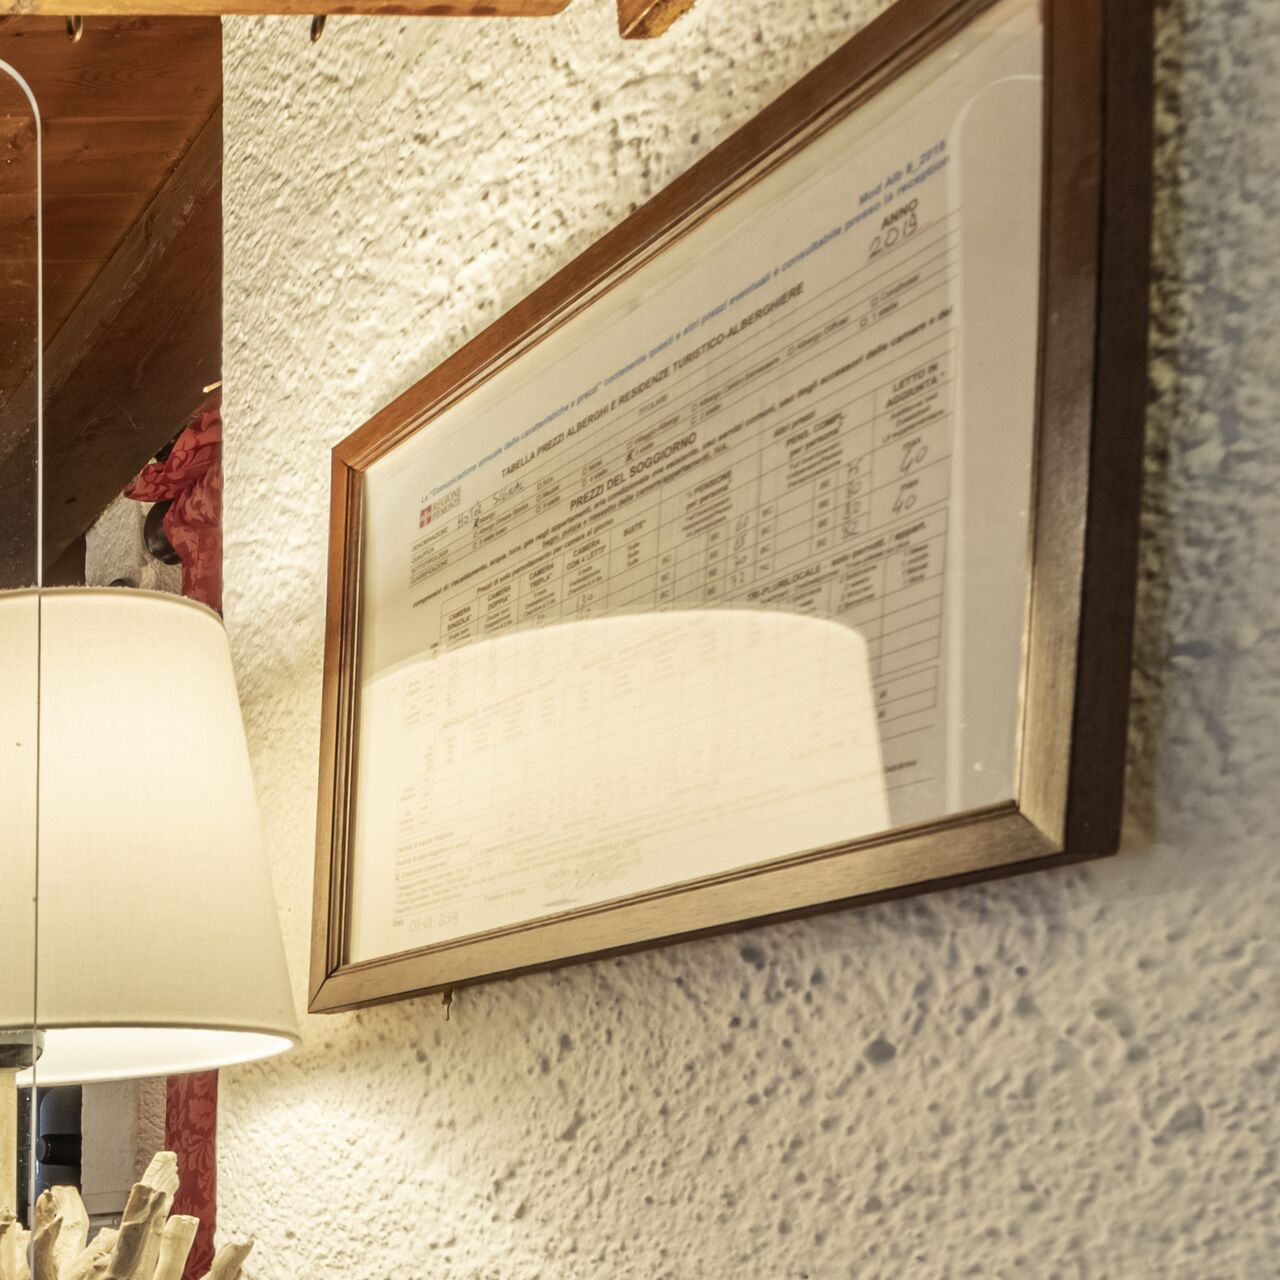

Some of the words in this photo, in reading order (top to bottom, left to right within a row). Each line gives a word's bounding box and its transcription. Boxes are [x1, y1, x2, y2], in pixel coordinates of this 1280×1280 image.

[881, 196, 918, 231] ANNO
[782, 223, 841, 272] consultabile
[845, 199, 880, 232] presso
[502, 449, 534, 478] TABELLA
[536, 431, 564, 457] PREZZI
[567, 404, 608, 438] ALBERGHI
[618, 365, 670, 406] RESIDENZE
[673, 280, 803, 372] TURISTICO-ALBERGHIERE
[893, 372, 919, 393] LETTO
[570, 482, 604, 510] PREZZI
[607, 469, 626, 489] DEL
[630, 431, 696, 477] SOGGIORNO
[432, 495, 461, 521] PIEMONTE
[433, 485, 461, 511] REGIONE
